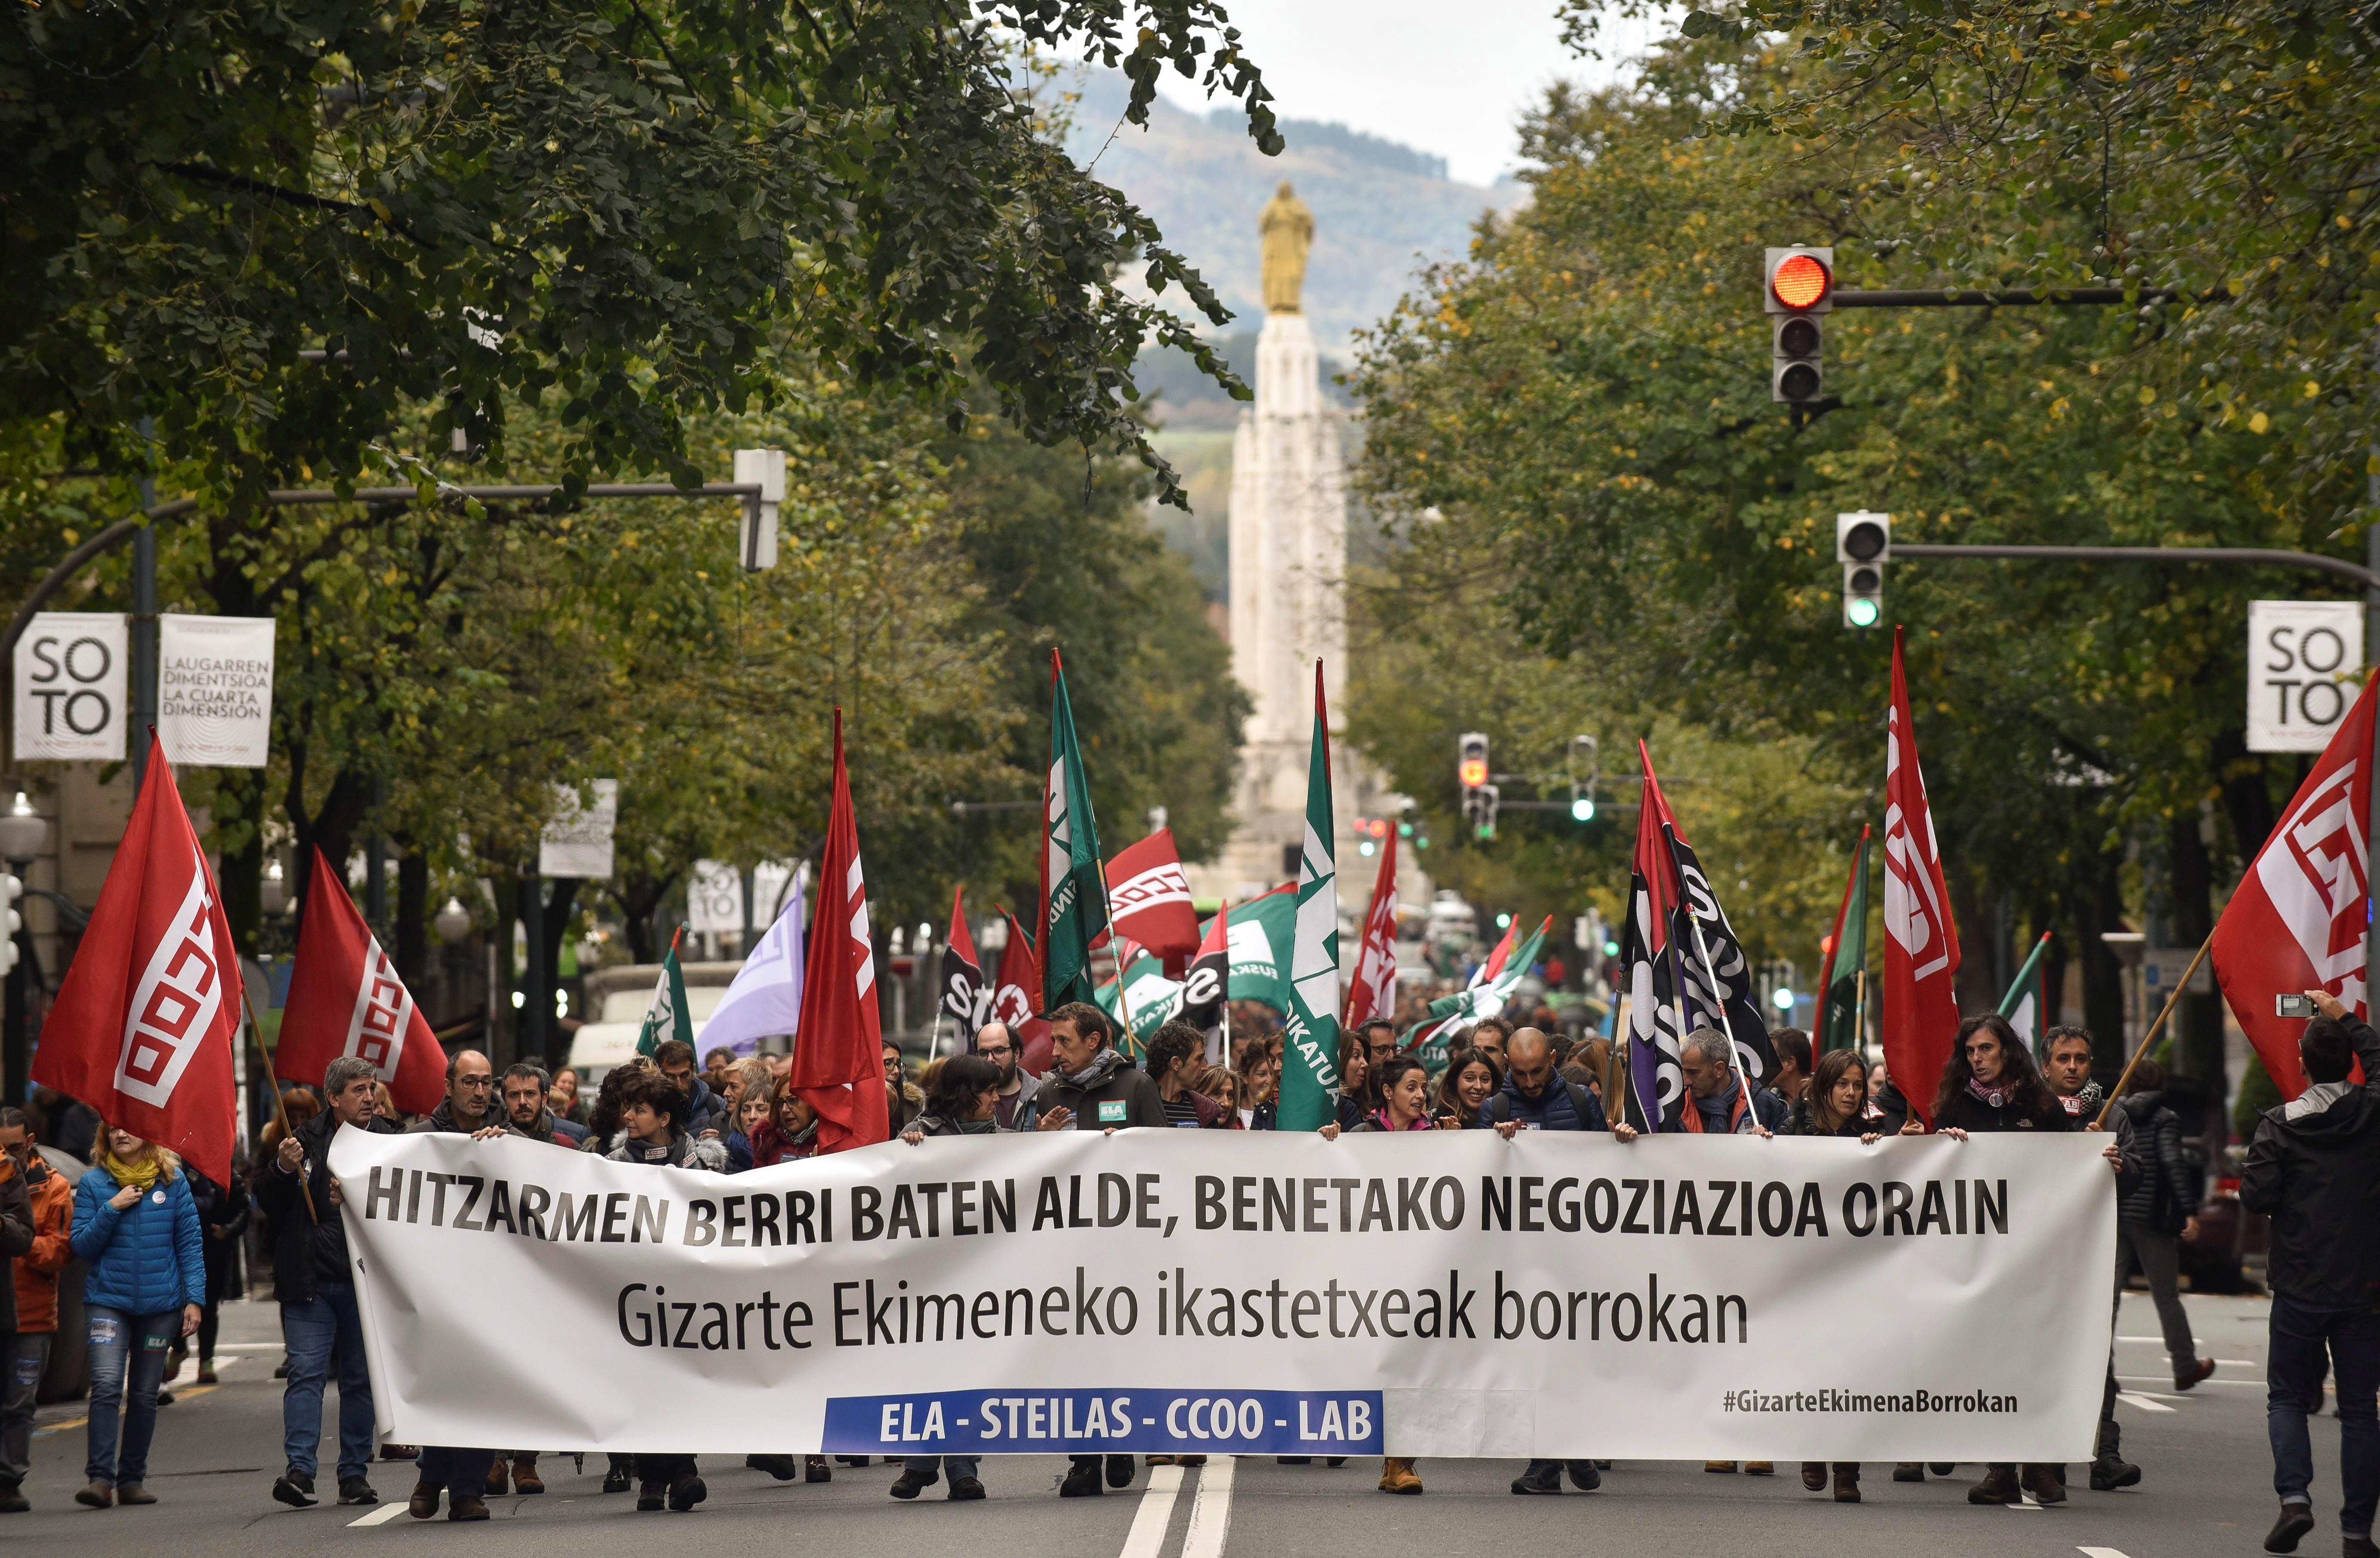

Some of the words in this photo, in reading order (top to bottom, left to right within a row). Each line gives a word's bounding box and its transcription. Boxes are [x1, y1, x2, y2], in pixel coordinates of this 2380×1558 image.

[31, 637, 111, 683] SO
[164, 656, 269, 674] LAUGARREN
[2266, 626, 2344, 673] SO
[163, 687, 184, 701] LA
[189, 689, 258, 705] CUARTA
[164, 670, 269, 688] DIMENTSIOA
[30, 689, 111, 735] TO
[2266, 679, 2345, 726] TO
[1101, 1105, 1123, 1117] ELA
[365, 1166, 669, 1243] HITZARMEN
[683, 1188, 832, 1247] BERRI
[852, 1178, 1016, 1241] BATEN
[1032, 1172, 1178, 1238] ALDE,
[1195, 1175, 1465, 1232] BENETAKO
[1481, 1176, 1829, 1237] NEGOZIAZIOA
[1842, 1179, 2009, 1237] ORAIN
[617, 1283, 813, 1350] Gizarte
[833, 1267, 1138, 1347] Ekimeneko
[1158, 1267, 1476, 1339] ikastetxeak
[1494, 1270, 1747, 1344] borrokan
[148, 1338, 167, 1347] ELA
[880, 1401, 945, 1442] ELA
[981, 1397, 1132, 1439] STEILAS
[1166, 1398, 1264, 1439] CCOO
[1299, 1400, 1372, 1441] LAB
[1723, 1389, 2018, 1413] #GizarteEkimenaBorrokan
